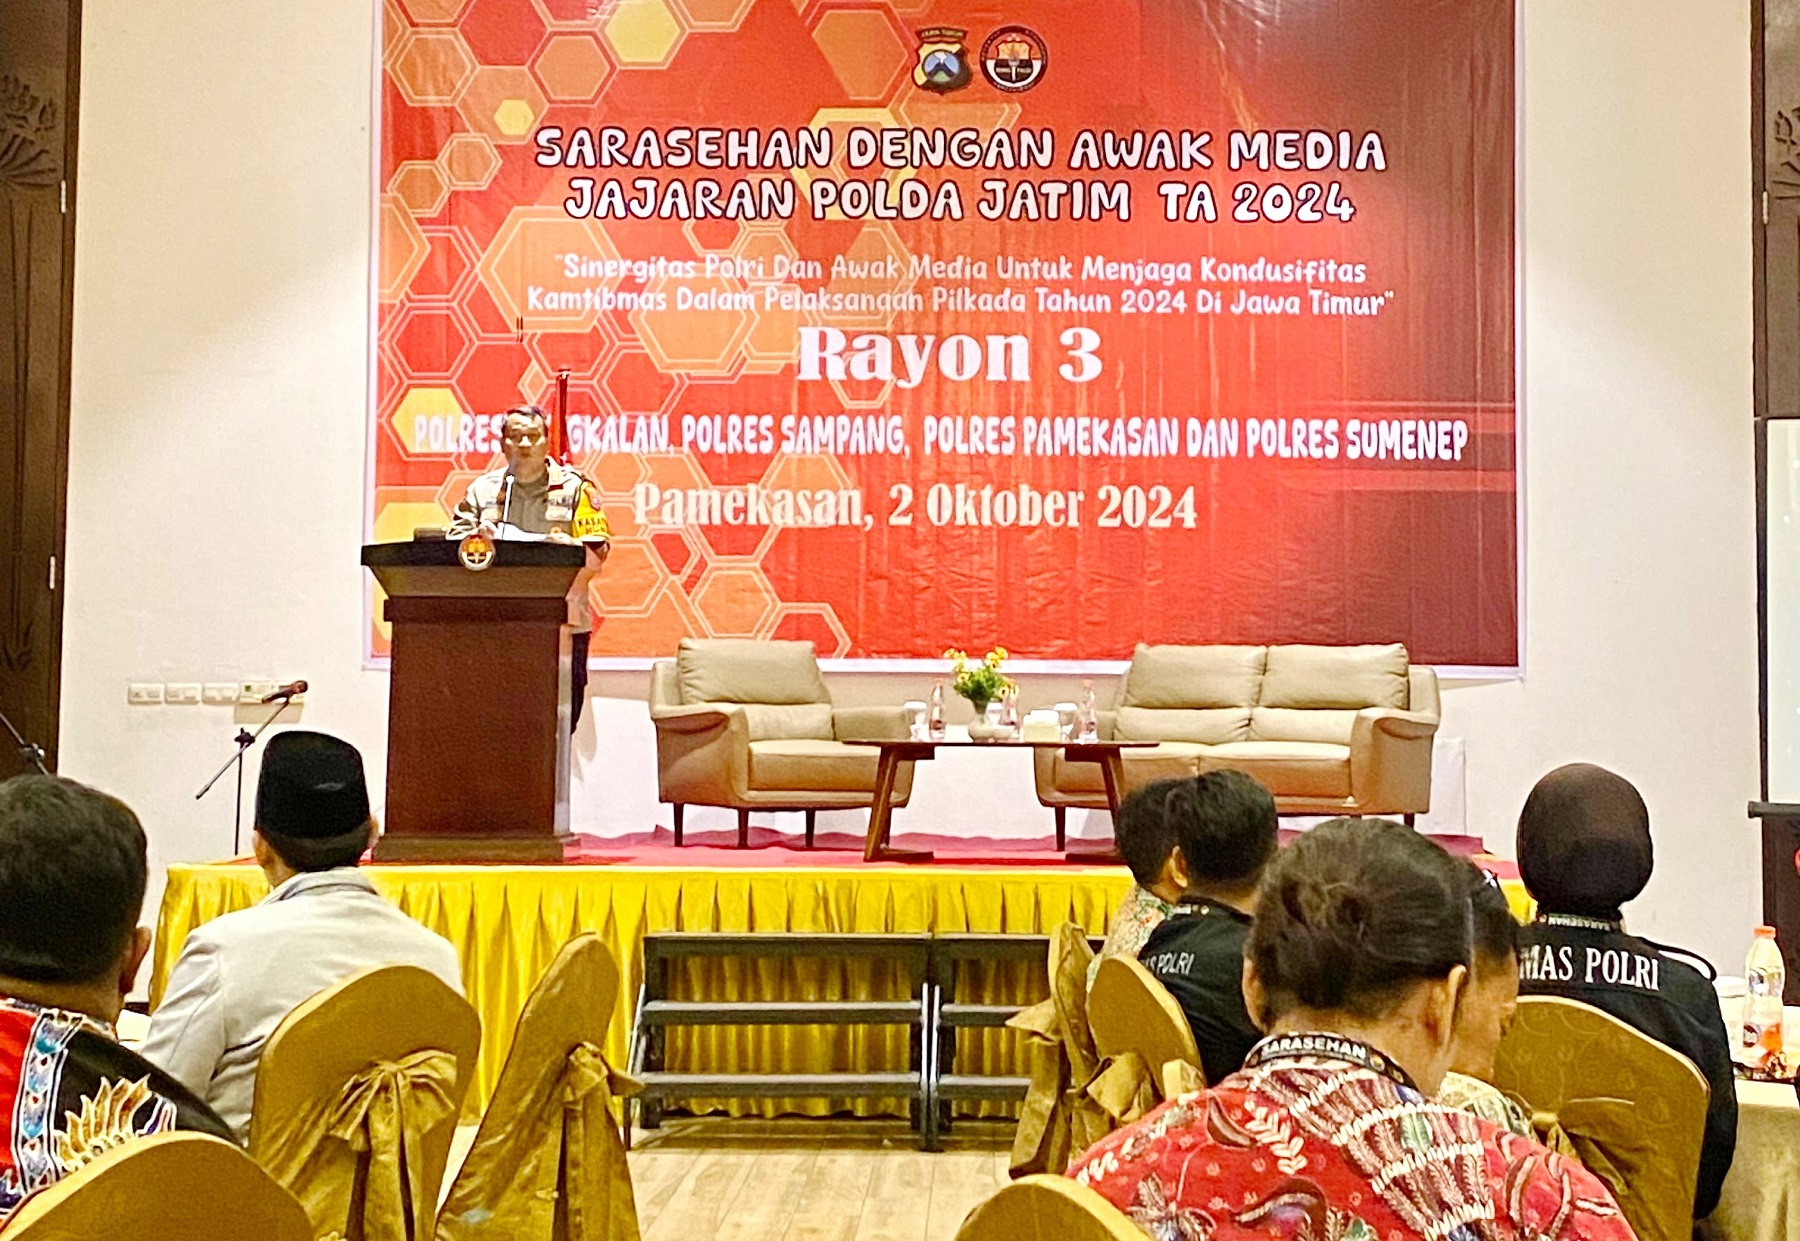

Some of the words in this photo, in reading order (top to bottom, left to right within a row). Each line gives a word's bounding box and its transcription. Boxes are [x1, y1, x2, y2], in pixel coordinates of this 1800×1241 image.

[534, 127, 832, 169] SARASEHAN
[847, 127, 1055, 170] DENGAN
[1069, 129, 1213, 170] AWAK
[1228, 130, 1387, 171] MEDIA
[564, 178, 795, 220] JAJARAN
[811, 178, 964, 221] POLDA
[977, 180, 1131, 220] JATIM
[1159, 181, 1217, 222] TA
[1233, 181, 1356, 223] 2024
[705, 252, 764, 279] Polri
[773, 253, 822, 279] Dan
[831, 253, 897, 280] Awak
[908, 255, 988, 280] Media
[996, 256, 1073, 282] Untuk
[1081, 257, 1191, 288] Menjaga
[1200, 257, 1367, 285] Kondusifitas
[528, 286, 666, 312] Kamtibmas
[676, 286, 756, 312] Dalam
[765, 286, 924, 312] Pelaksanaan
[933, 285, 1027, 313] Pilkada
[1034, 287, 1111, 313] Tahun
[1120, 289, 1187, 314] 2024
[1196, 289, 1222, 315] Di
[1230, 290, 1301, 315] Jawa
[1309, 289, 1395, 316] Timur"
[796, 326, 1030, 389] Rayon
[1058, 326, 1103, 382] 3
[413, 413, 502, 452] POLRES
[548, 413, 674, 458] GKALAN,
[682, 414, 773, 454] POLRES
[780, 414, 911, 459] SAMPANG,
[923, 415, 1016, 455] POLRES
[1023, 416, 1179, 457] PAMEKASAN
[1186, 416, 1239, 459] DAN
[1246, 417, 1340, 459] POLRES
[1346, 418, 1469, 461] SUMENEP
[634, 482, 874, 531] Pamekasan,
[888, 483, 913, 527] 2
[926, 483, 1085, 527] Oktober
[1097, 484, 1198, 529] 2024
[1157, 952, 1195, 975] POLRI
[1584, 947, 1660, 991] POLRI
[1261, 1036, 1367, 1059] SARASEHAN
